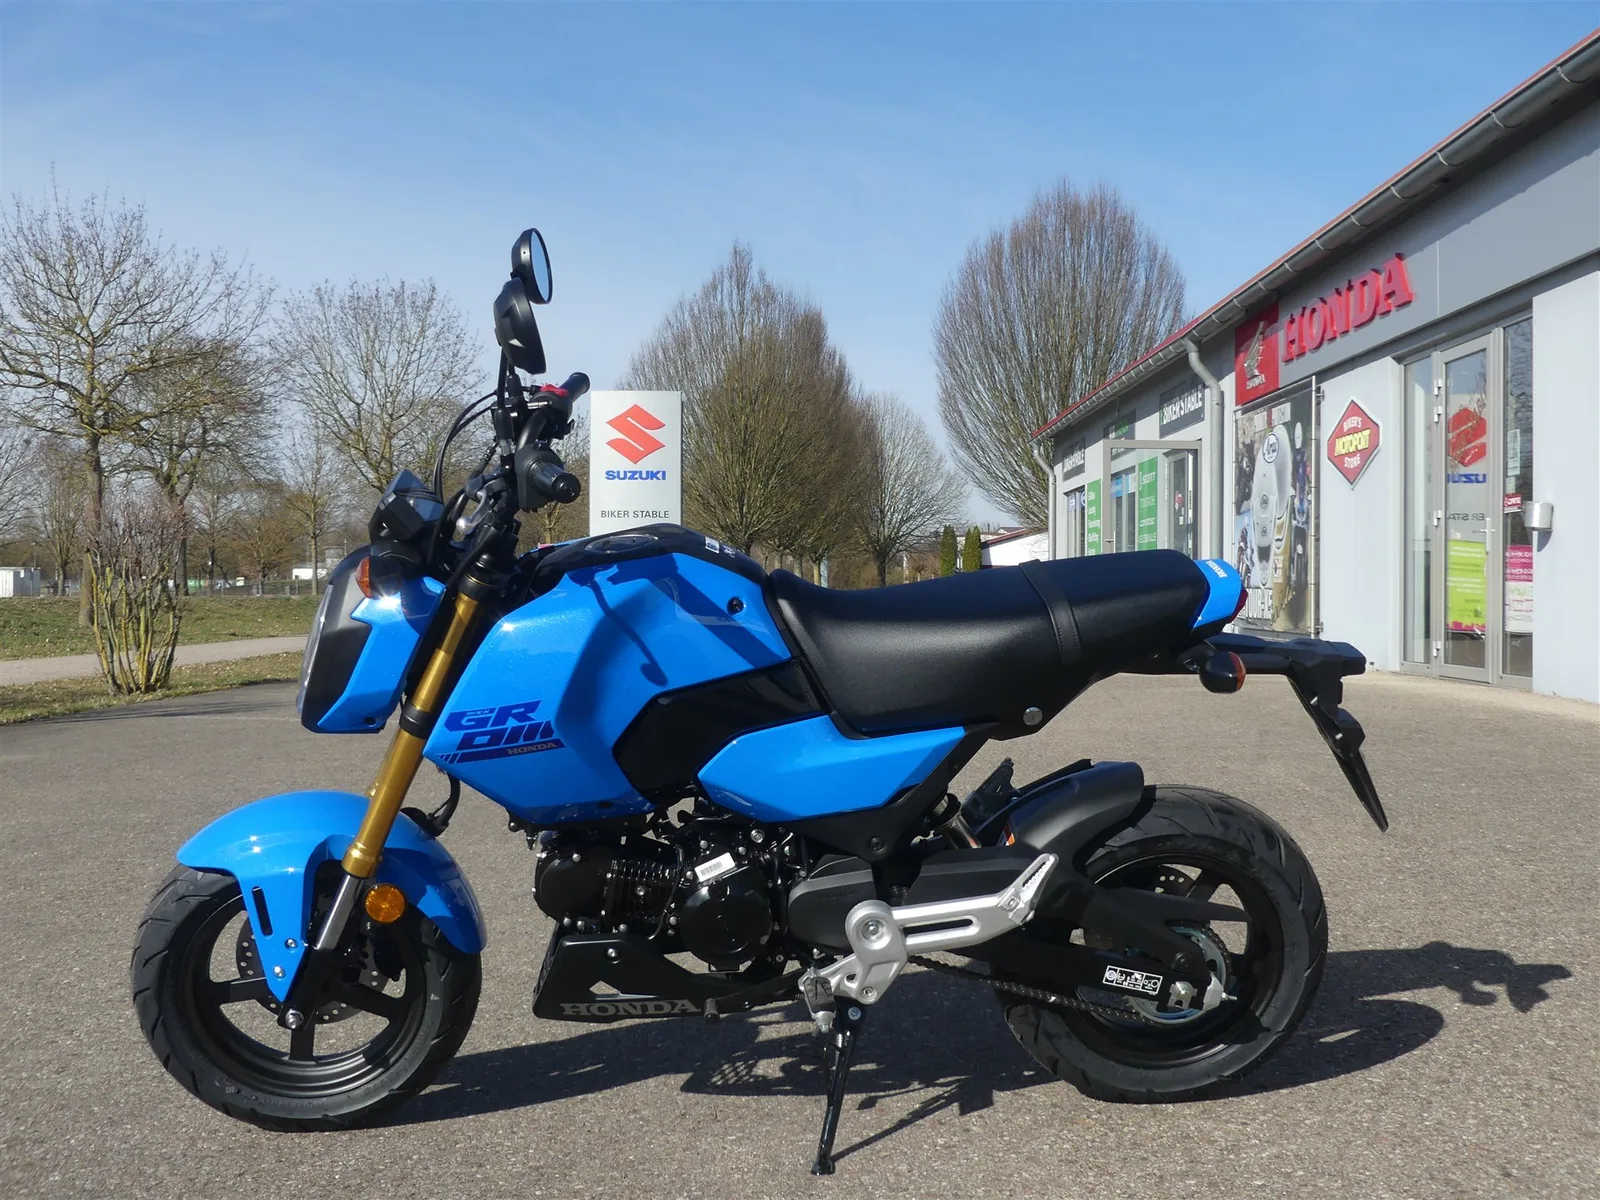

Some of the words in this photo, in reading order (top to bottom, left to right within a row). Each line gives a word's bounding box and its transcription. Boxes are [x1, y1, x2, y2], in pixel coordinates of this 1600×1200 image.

[1282, 254, 1414, 362] HONDA
[1334, 428, 1371, 457] MOTOPORT
[1344, 453, 1361, 469] STORE
[605, 470, 667, 481] SUZUKI
[601, 510, 630, 519] BIKER
[633, 510, 670, 519] STABLE
[506, 742, 557, 755] HONDA
[560, 999, 701, 1017] HONDA
